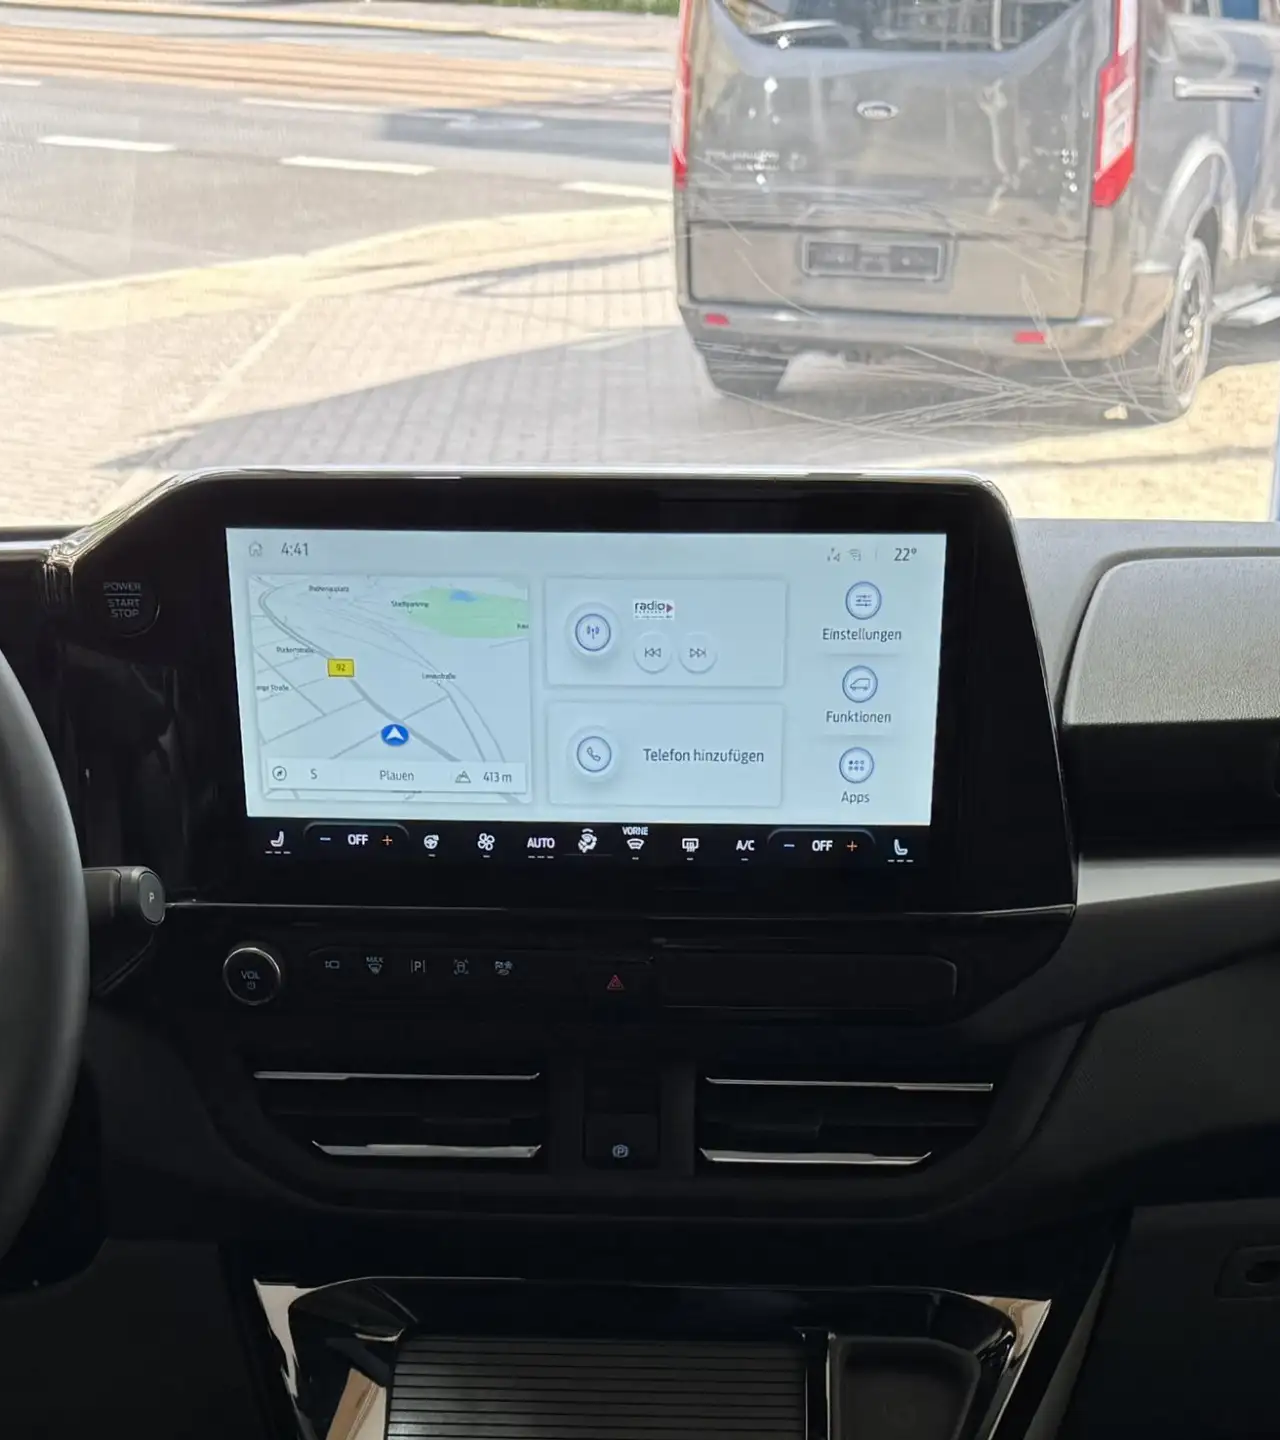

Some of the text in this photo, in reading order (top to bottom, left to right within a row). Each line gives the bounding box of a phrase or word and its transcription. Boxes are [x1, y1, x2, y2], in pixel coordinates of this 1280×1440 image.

[281, 542, 310, 557] 4:41
[894, 547, 918, 562] 22°
[102, 581, 141, 591] POWER
[107, 599, 140, 608] START
[634, 600, 666, 611] radio
[110, 608, 140, 618] STOP
[822, 627, 902, 643] Einstellungen
[335, 663, 347, 672] 92
[825, 710, 892, 723] Funktionen
[643, 748, 765, 764] Telefon hinzufügen
[310, 769, 318, 780] S
[379, 770, 415, 782] Plauen
[483, 772, 513, 783] 413 m
[841, 791, 871, 804] Apps
[621, 826, 649, 836] VORNE
[347, 833, 369, 846] OFF
[527, 837, 556, 849] AUTO
[735, 839, 756, 851] A/C
[811, 839, 834, 852] OFF
[240, 970, 261, 980] VOL
